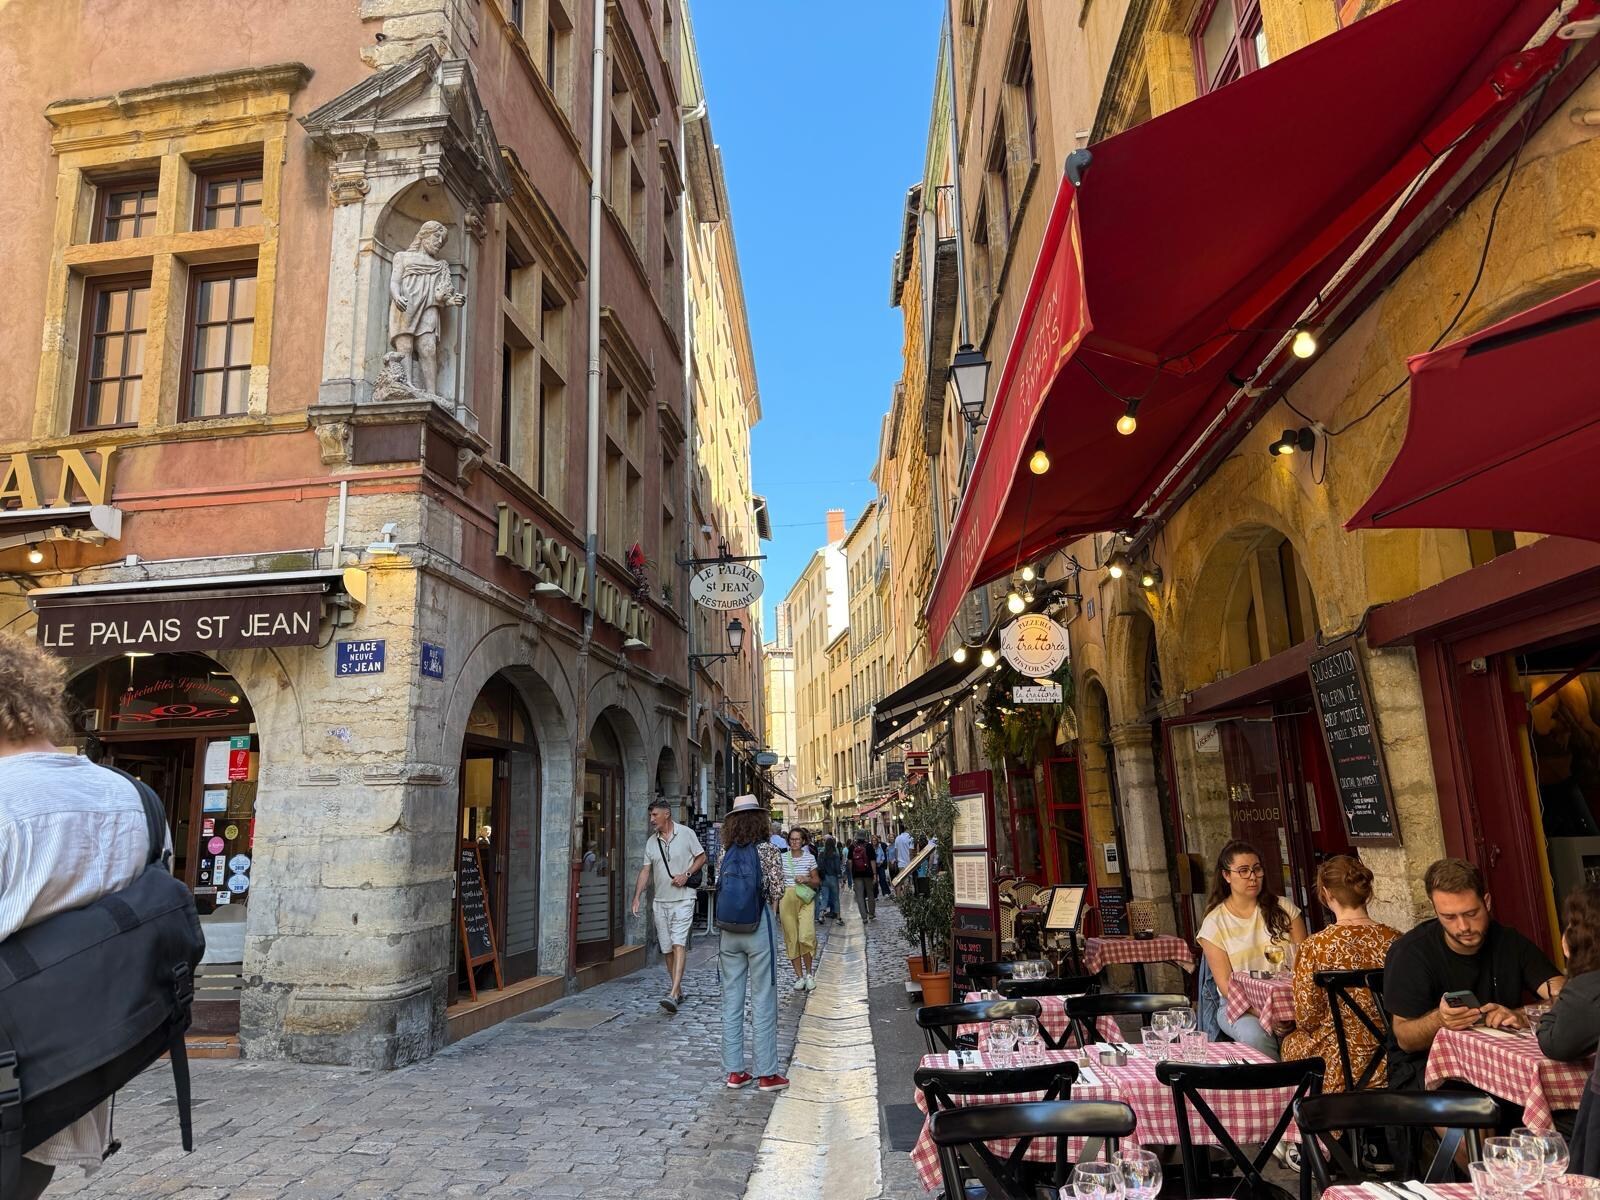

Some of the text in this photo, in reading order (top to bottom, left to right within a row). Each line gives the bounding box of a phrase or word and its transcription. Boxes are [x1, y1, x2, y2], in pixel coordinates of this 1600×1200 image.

[698, 564, 758, 583] LE PALAIS
[720, 582, 750, 593] JEAN
[700, 592, 755, 608] RESTAURANT
[43, 611, 312, 647] LE PALAIS ST JEAN
[1018, 620, 1052, 631] PIZZERIA
[346, 642, 377, 653] PLACE
[1002, 636, 1013, 650] la
[349, 652, 374, 661] NEUVE
[354, 661, 381, 673] JEAN
[1013, 656, 1057, 672] RISTORANTE
[1312, 650, 1356, 683] SUGGESTION
